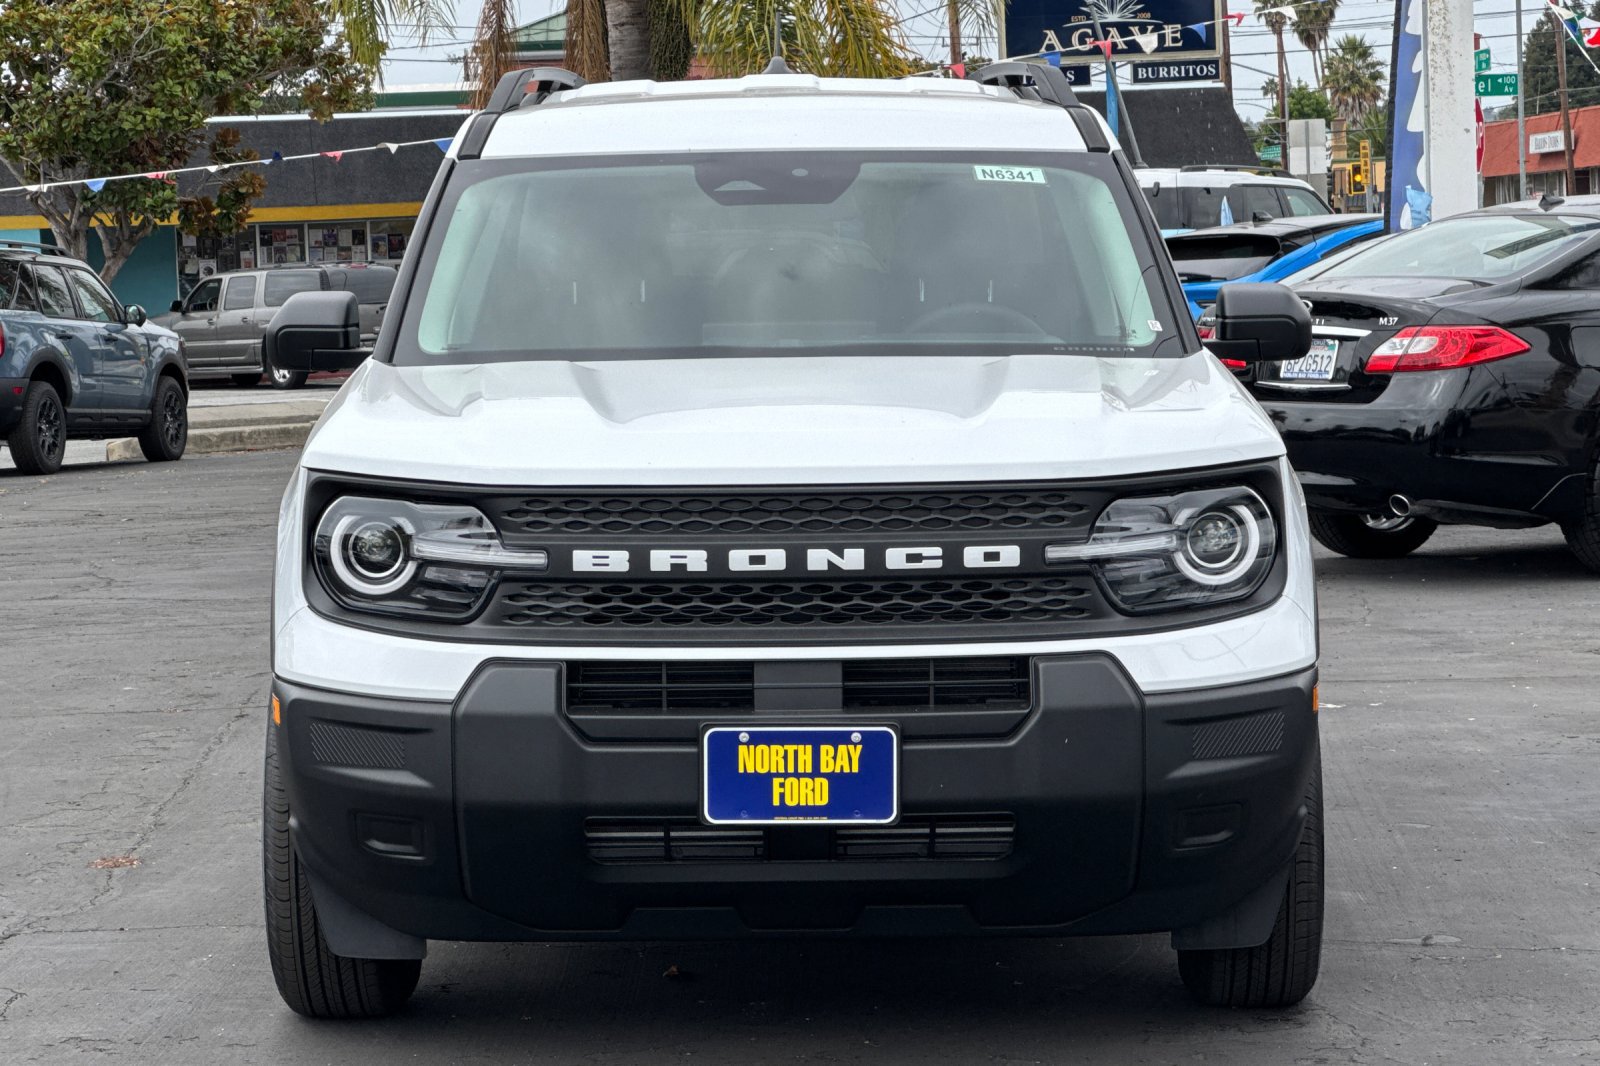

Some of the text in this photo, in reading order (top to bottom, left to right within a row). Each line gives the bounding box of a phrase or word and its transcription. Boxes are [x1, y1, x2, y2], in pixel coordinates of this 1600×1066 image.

[1039, 23, 1184, 53] AGAVE
[1137, 63, 1216, 79] BURRITOS
[1503, 76, 1516, 84] 100
[981, 168, 1035, 182] N6341
[1379, 317, 1399, 326] M37
[572, 545, 1021, 572] BRONCO
[738, 744, 863, 773] NORTH BAY
[772, 777, 829, 806] FORD
